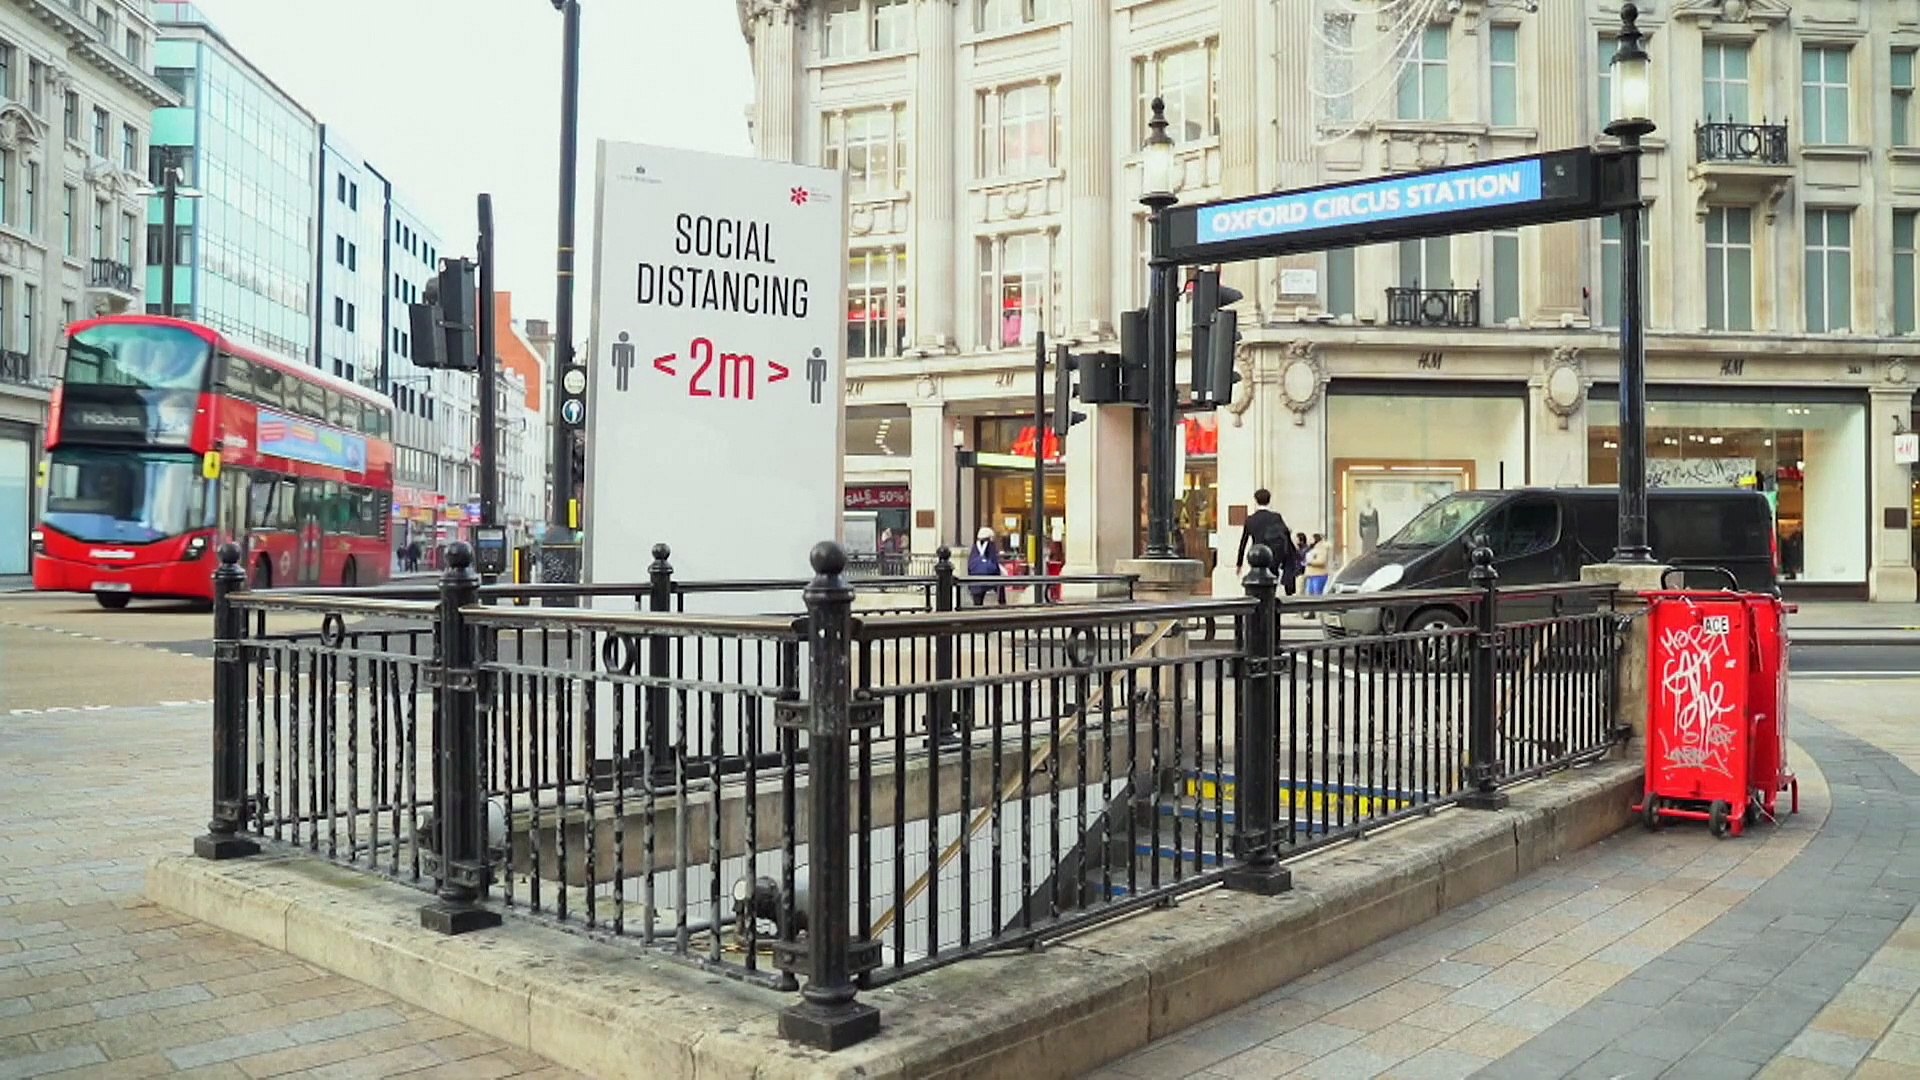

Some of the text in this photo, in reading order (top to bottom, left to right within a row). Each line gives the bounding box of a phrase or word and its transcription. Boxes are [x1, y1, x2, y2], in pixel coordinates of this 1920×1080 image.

[1212, 171, 1521, 233] OXFORD CIRCUS STATION
[675, 213, 776, 264] SOCIAL
[636, 263, 809, 319] DISTANCING
[688, 336, 755, 401] 2m
[845, 488, 872, 506] SALE
[1704, 617, 1729, 633] ACE
